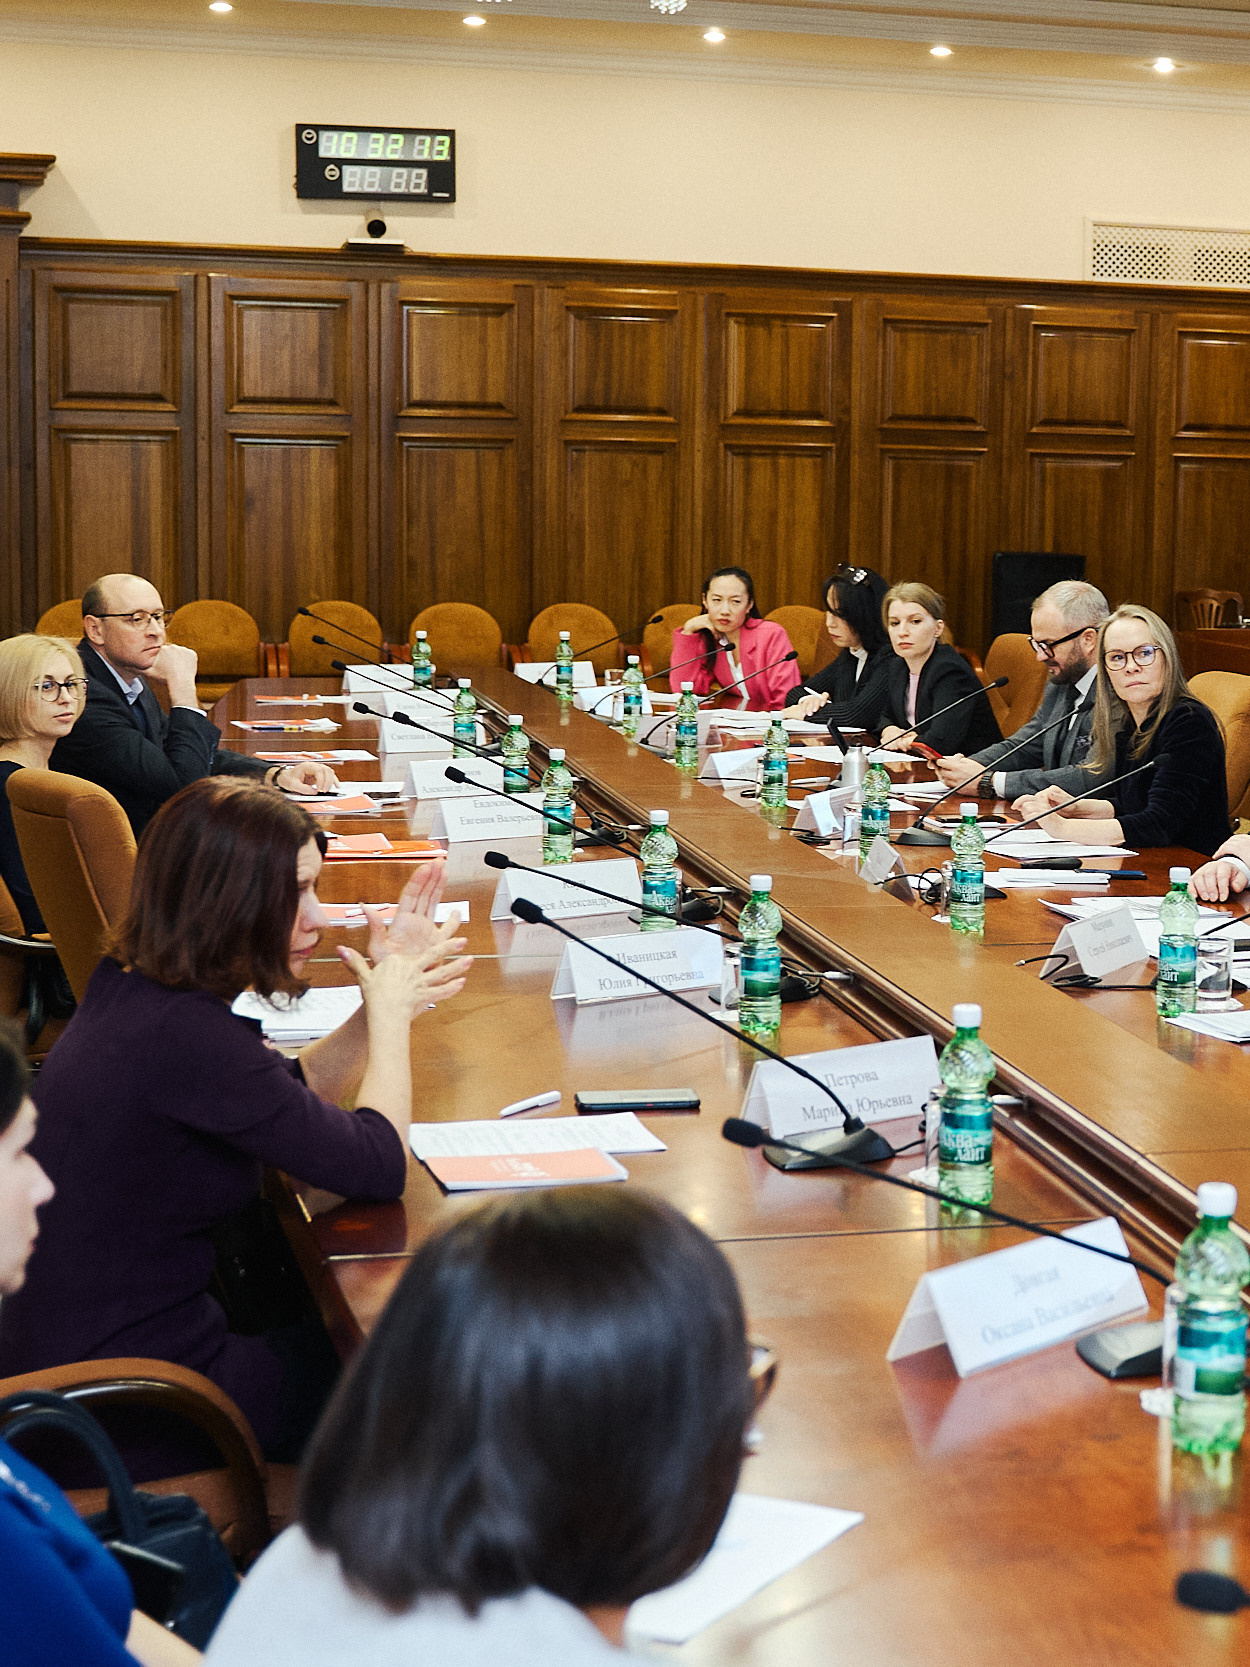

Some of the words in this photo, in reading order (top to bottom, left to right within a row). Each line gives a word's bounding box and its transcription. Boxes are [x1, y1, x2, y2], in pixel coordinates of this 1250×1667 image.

[616, 949, 679, 966] Иваницкая
[598, 976, 633, 991] Юлия
[824, 1070, 879, 1089] Петрова
[855, 1093, 913, 1115] Юрьевна
[954, 1146, 985, 1162] лайт
